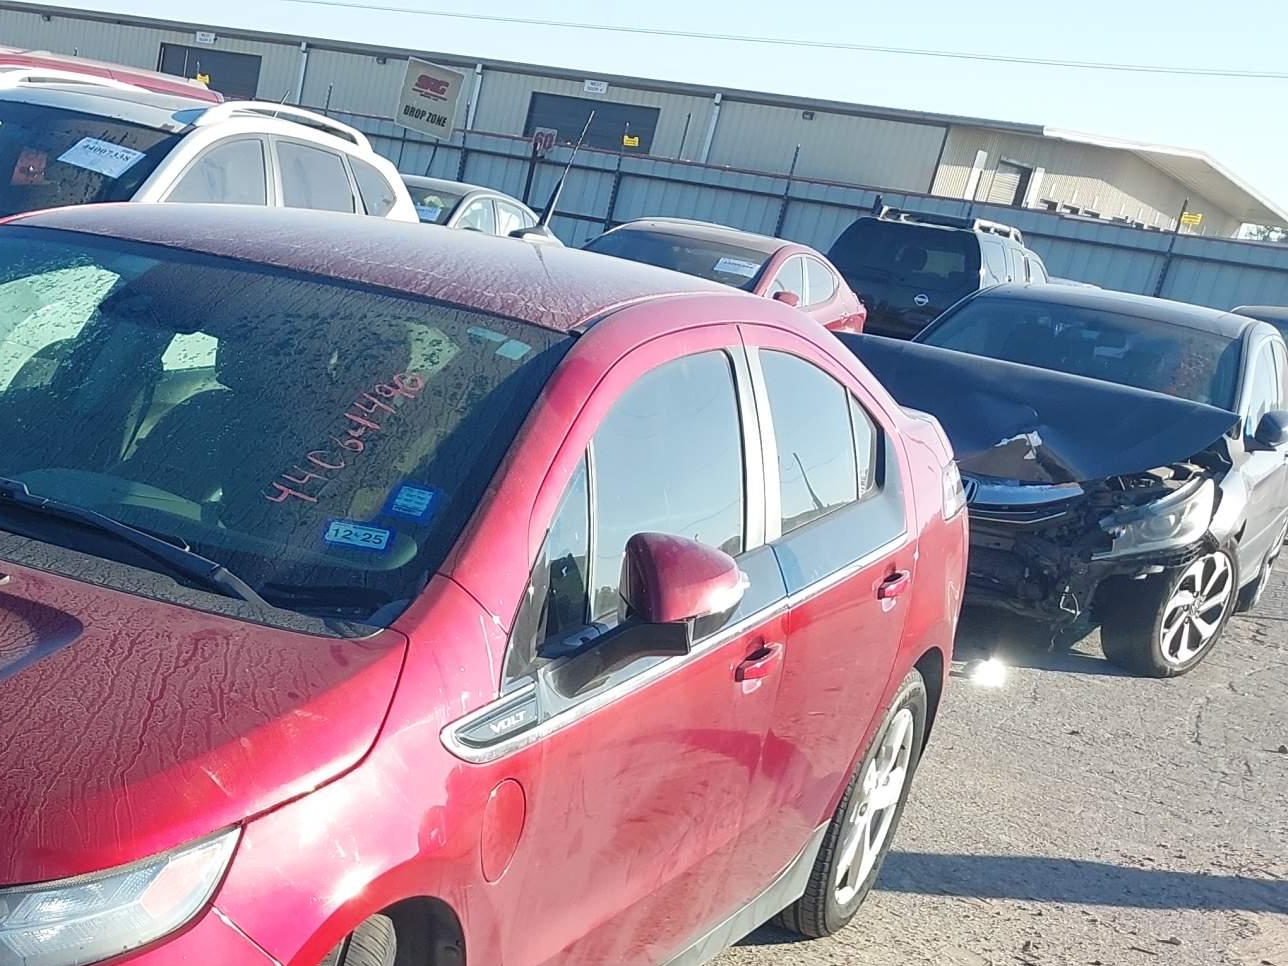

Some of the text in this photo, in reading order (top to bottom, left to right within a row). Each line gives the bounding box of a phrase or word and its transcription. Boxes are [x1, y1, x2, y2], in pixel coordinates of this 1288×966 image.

[403, 104, 448, 128] DROP ZONE
[490, 711, 526, 733] VOLT
